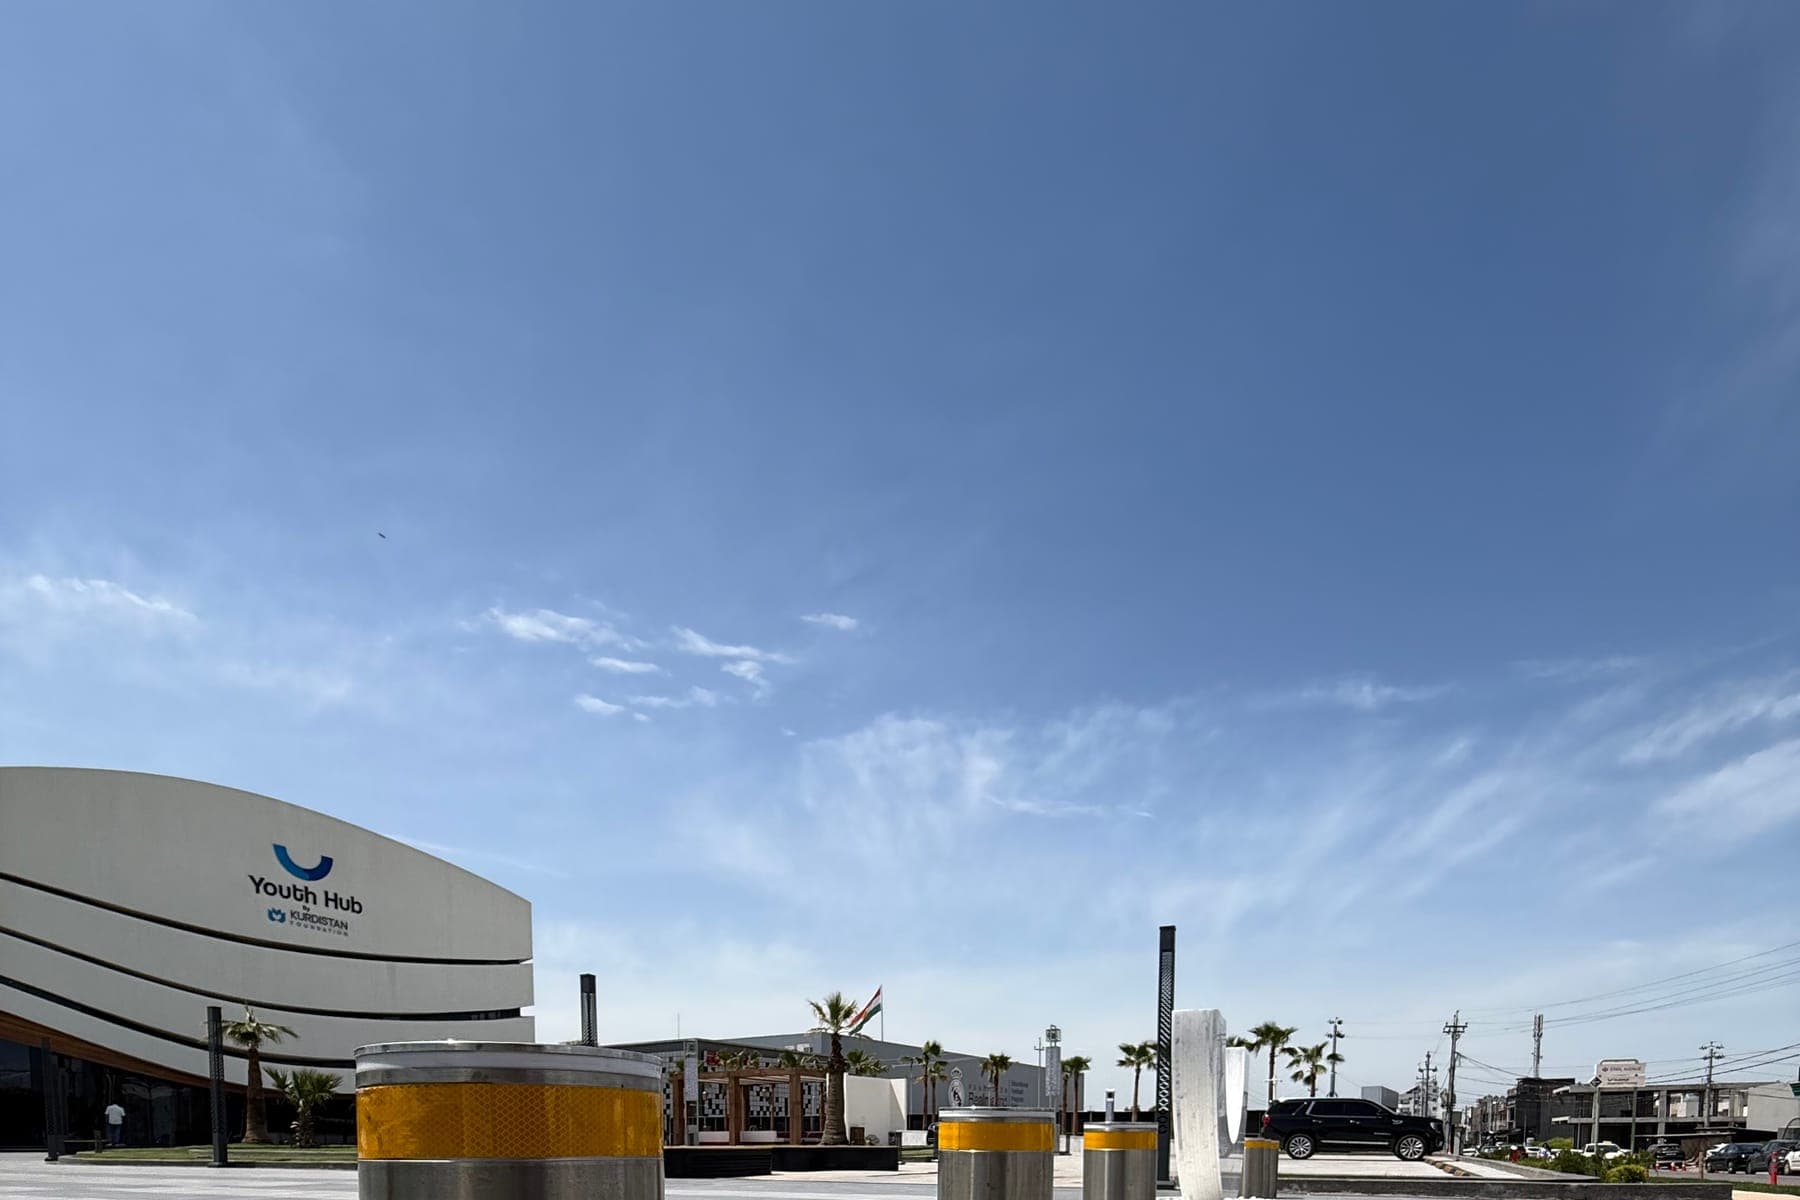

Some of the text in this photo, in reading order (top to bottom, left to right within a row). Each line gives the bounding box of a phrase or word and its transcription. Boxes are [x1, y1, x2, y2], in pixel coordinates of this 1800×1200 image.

[248, 875, 363, 914] Youth Hub
[290, 910, 348, 930] KURDISTAN
